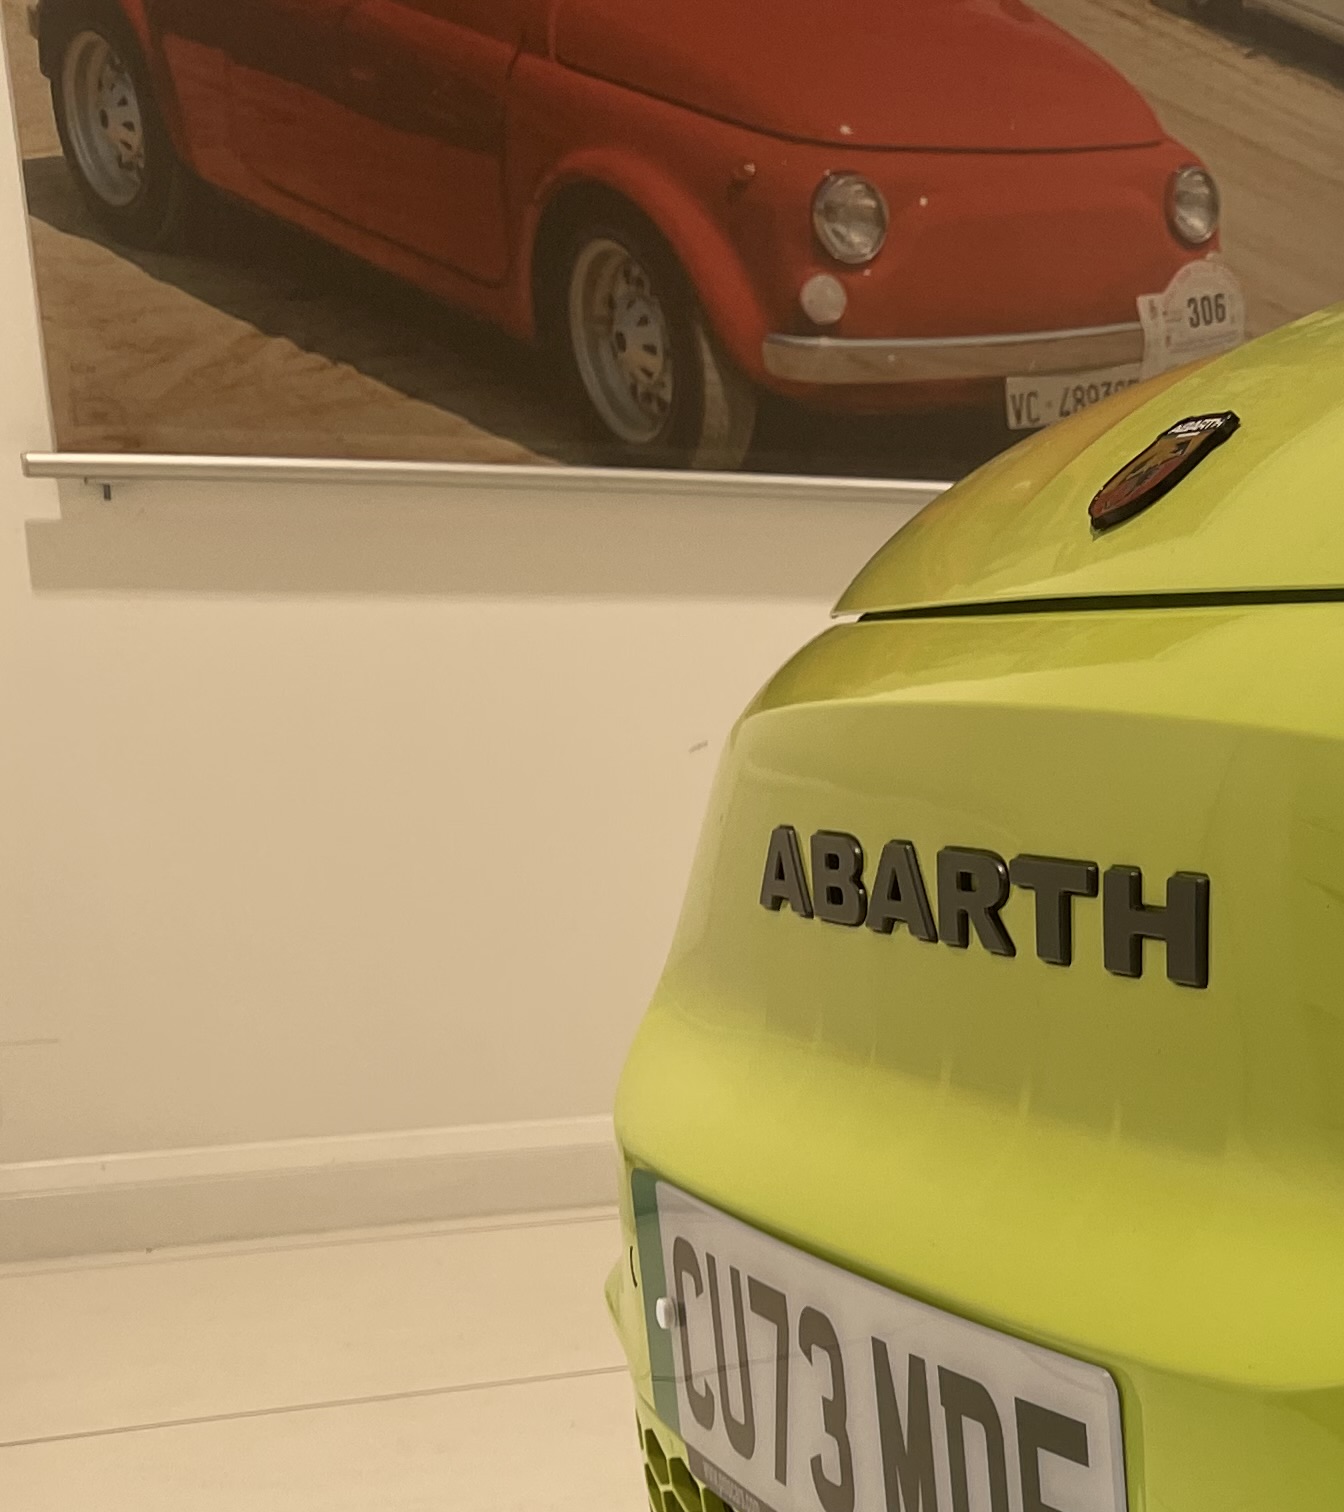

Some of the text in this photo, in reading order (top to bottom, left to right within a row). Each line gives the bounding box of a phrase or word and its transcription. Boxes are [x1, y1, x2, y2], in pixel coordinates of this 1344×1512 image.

[1187, 292, 1228, 330] 306
[1009, 390, 1041, 425] VC
[1167, 416, 1228, 436] ABARTH
[759, 824, 1211, 989] ABARTH
